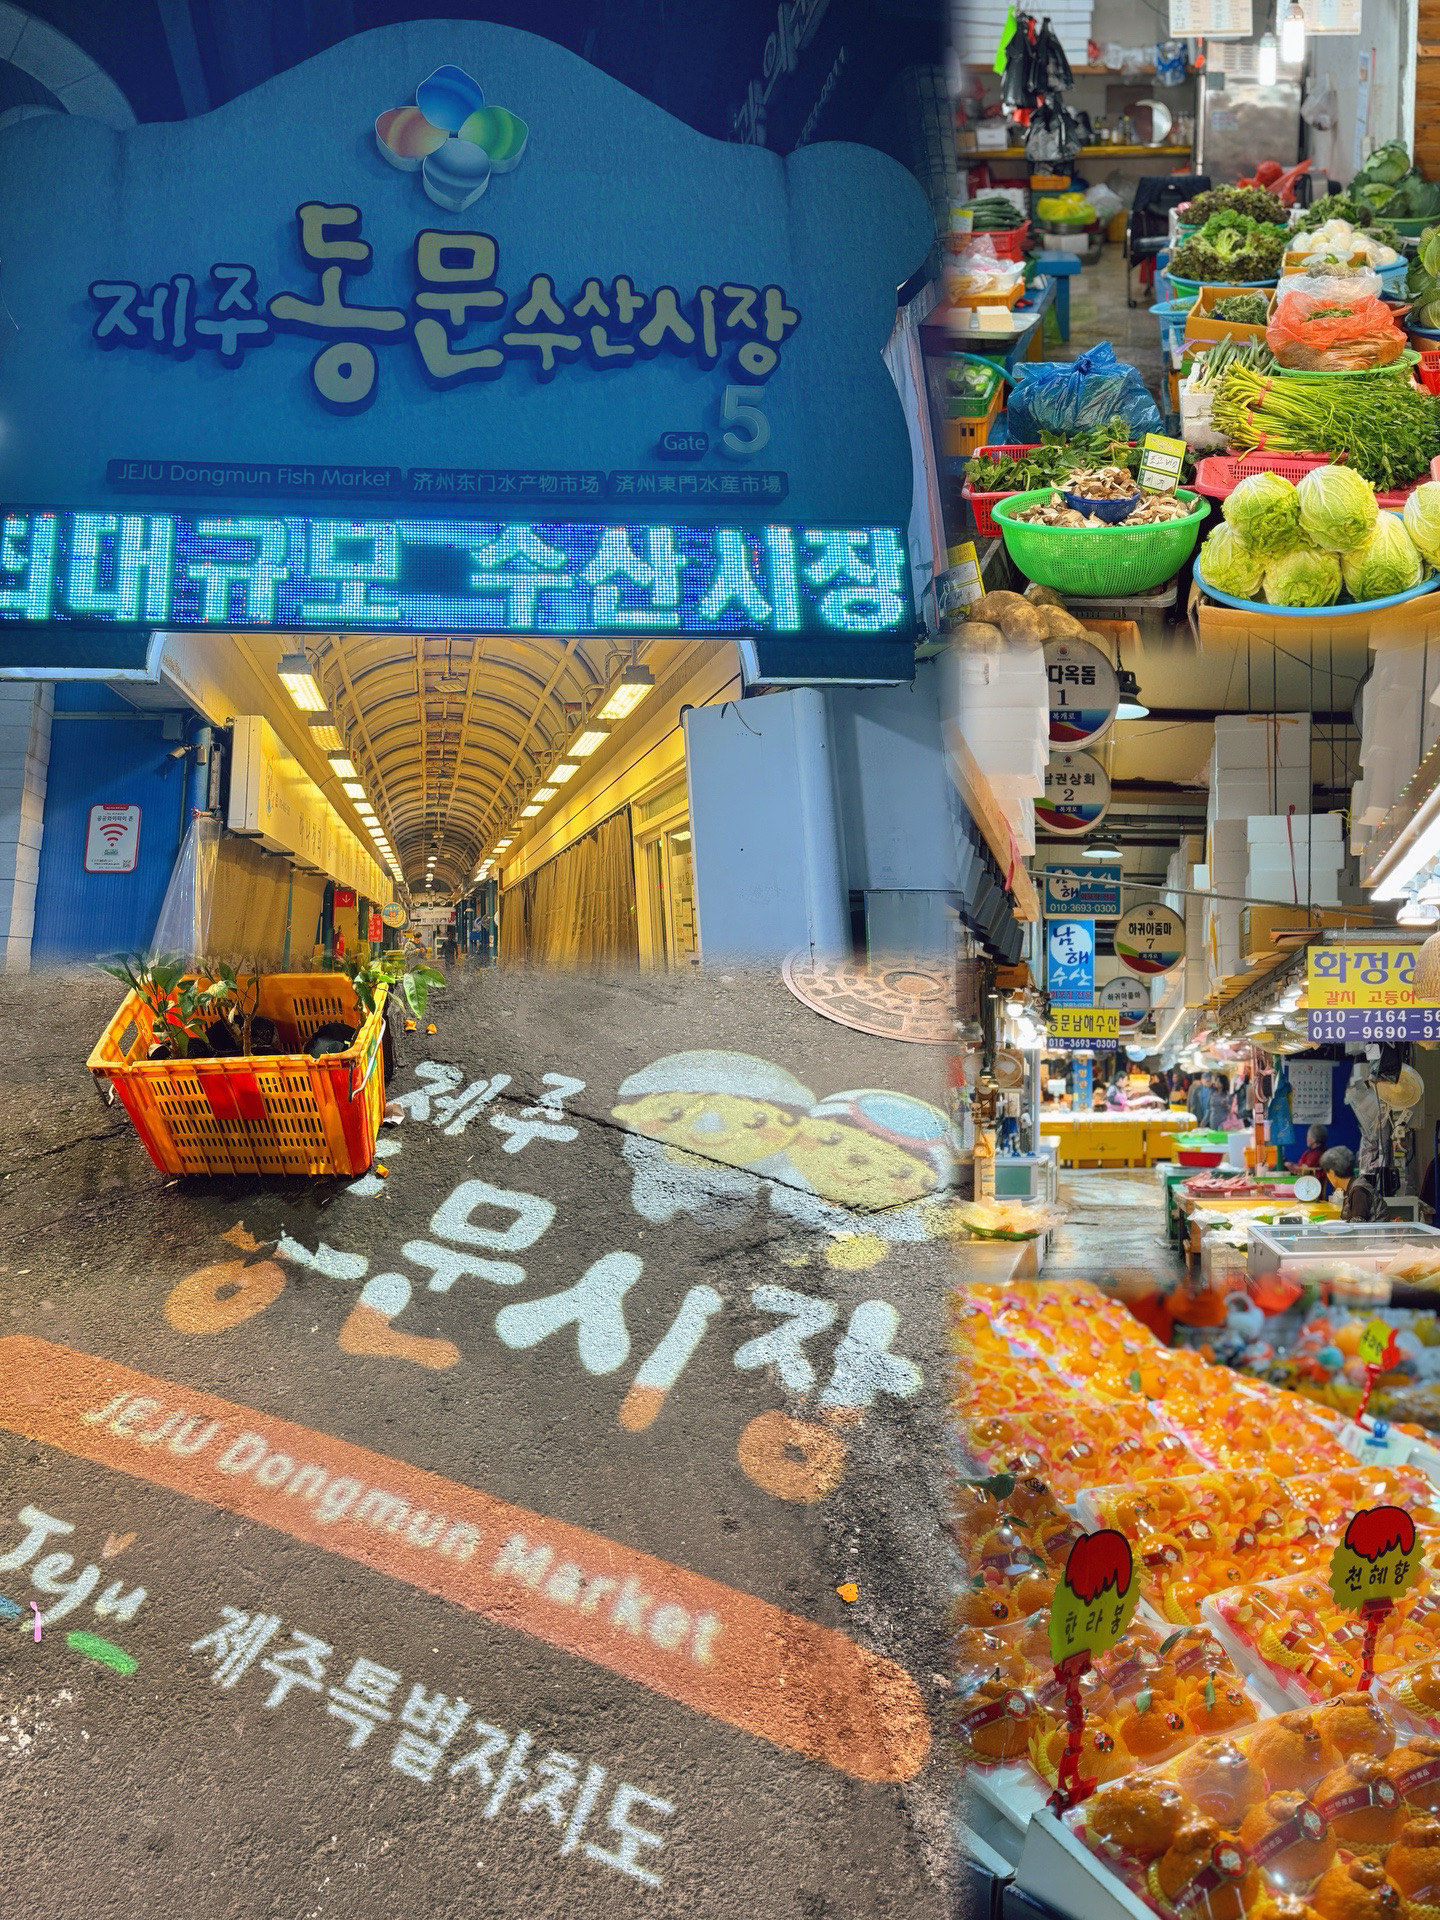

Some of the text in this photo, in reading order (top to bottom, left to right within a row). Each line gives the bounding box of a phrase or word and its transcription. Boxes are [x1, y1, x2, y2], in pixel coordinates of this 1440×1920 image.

[663, 383, 771, 454] Gate 5
[117, 463, 392, 487] JEJU Dongmun Fish Market
[413, 472, 600, 494] 济州东门水产物市场
[469, 524, 906, 631] 수산시장
[1046, 664, 1097, 686] 다옥돔
[1057, 688, 1070, 706] 1
[1063, 788, 1075, 801] 2
[1053, 926, 1089, 965] 남해
[1146, 938, 1155, 949] 7
[1049, 966, 1092, 987] 수산
[1324, 990, 1416, 1005] 갈치 고등어
[385, 1060, 587, 1154] 제주
[79, 1389, 723, 1667] JEJU Dongmun Market
[189, 1603, 677, 1887] 제주특별자치도
